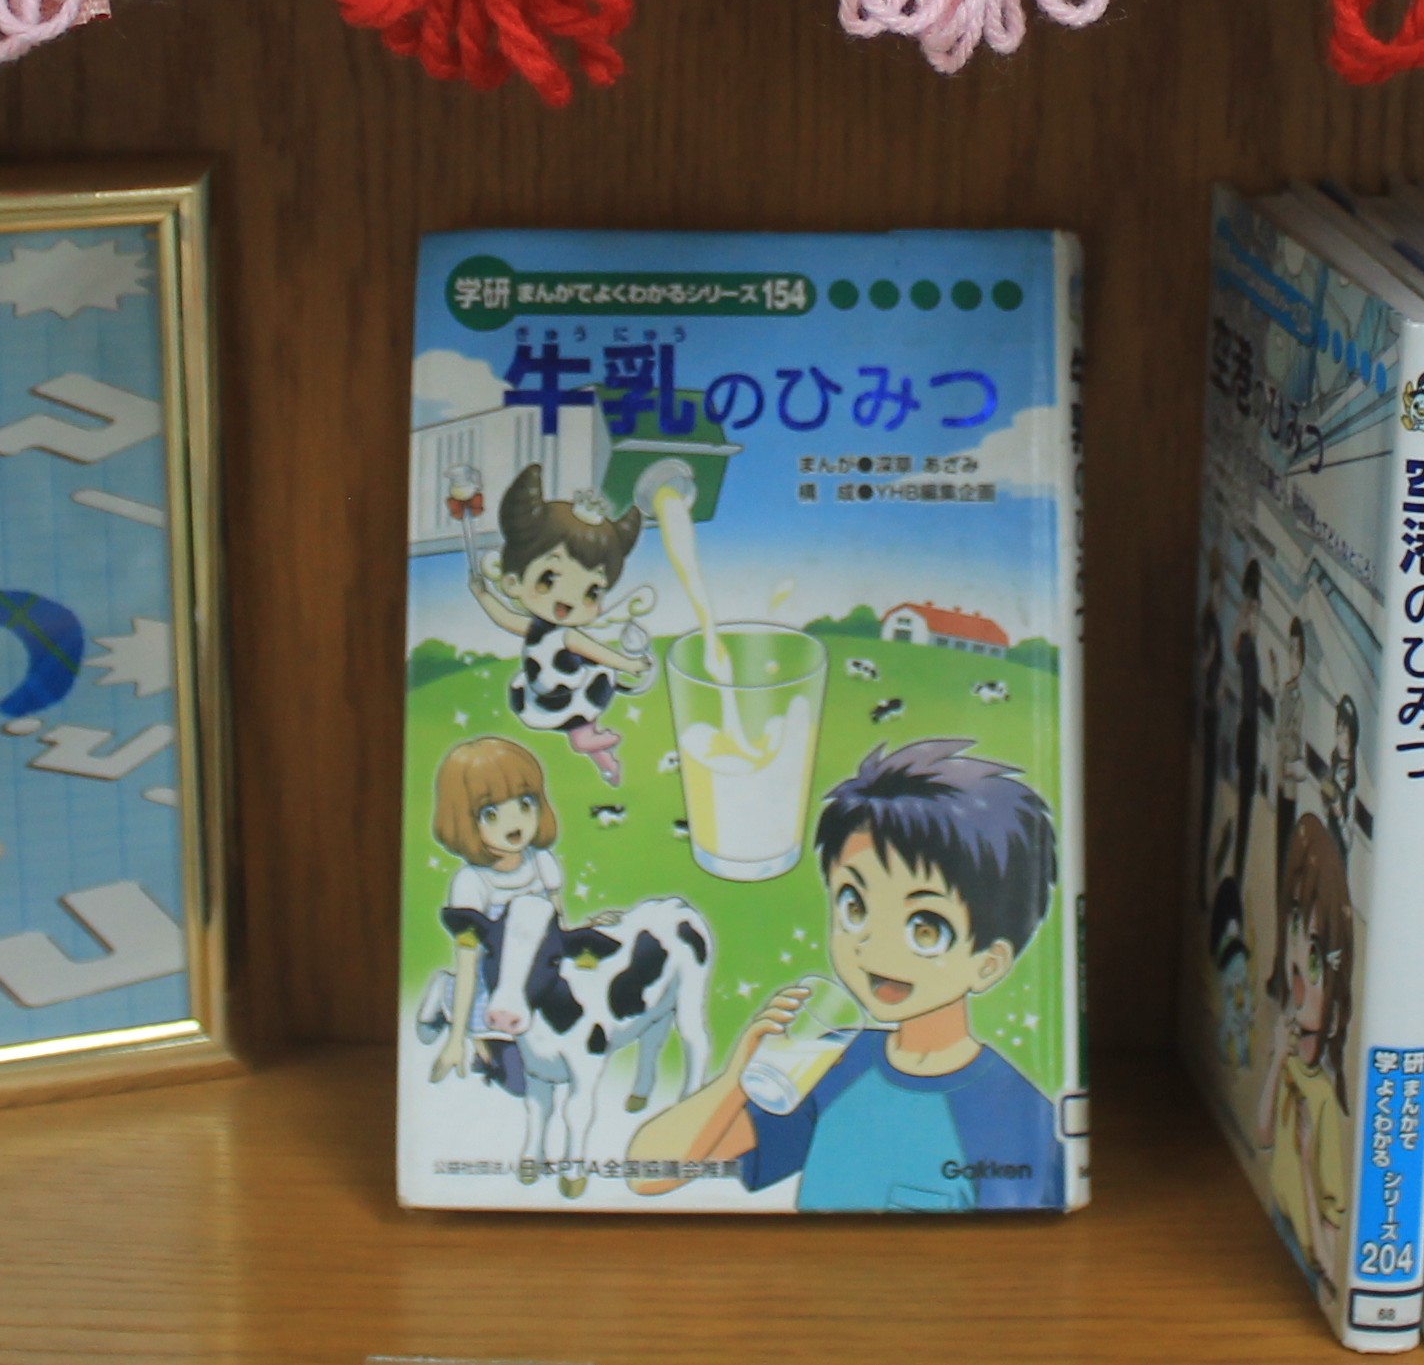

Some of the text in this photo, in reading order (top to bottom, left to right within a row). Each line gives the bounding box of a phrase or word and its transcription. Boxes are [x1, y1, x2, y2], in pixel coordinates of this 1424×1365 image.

[454, 277, 511, 311] 学研
[762, 279, 808, 311] 154
[502, 341, 999, 436] 牛乳のひみつ
[940, 1159, 1034, 1183] Gakken
[1380, 1172, 1404, 1241] シリーズ
[1359, 1242, 1415, 1276] 204
